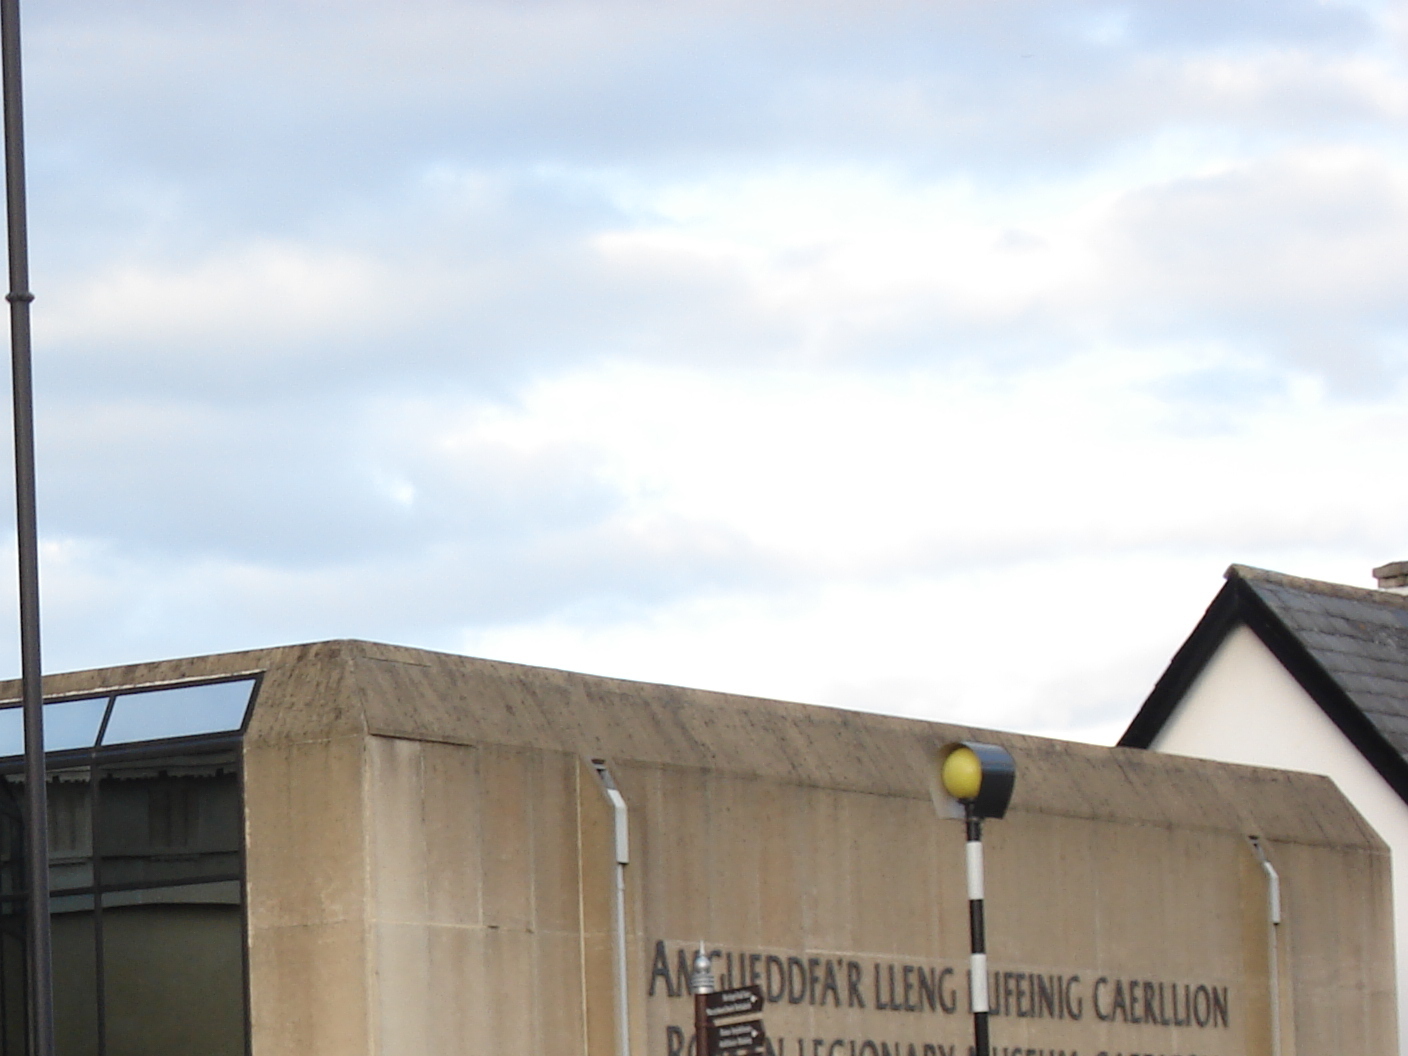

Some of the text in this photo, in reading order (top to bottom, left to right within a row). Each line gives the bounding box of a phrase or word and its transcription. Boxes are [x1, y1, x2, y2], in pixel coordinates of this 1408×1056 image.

[875, 963, 958, 1014] LLENG
[967, 968, 1084, 1021] UFEINIG
[1094, 976, 1229, 1028] CAERLLION
